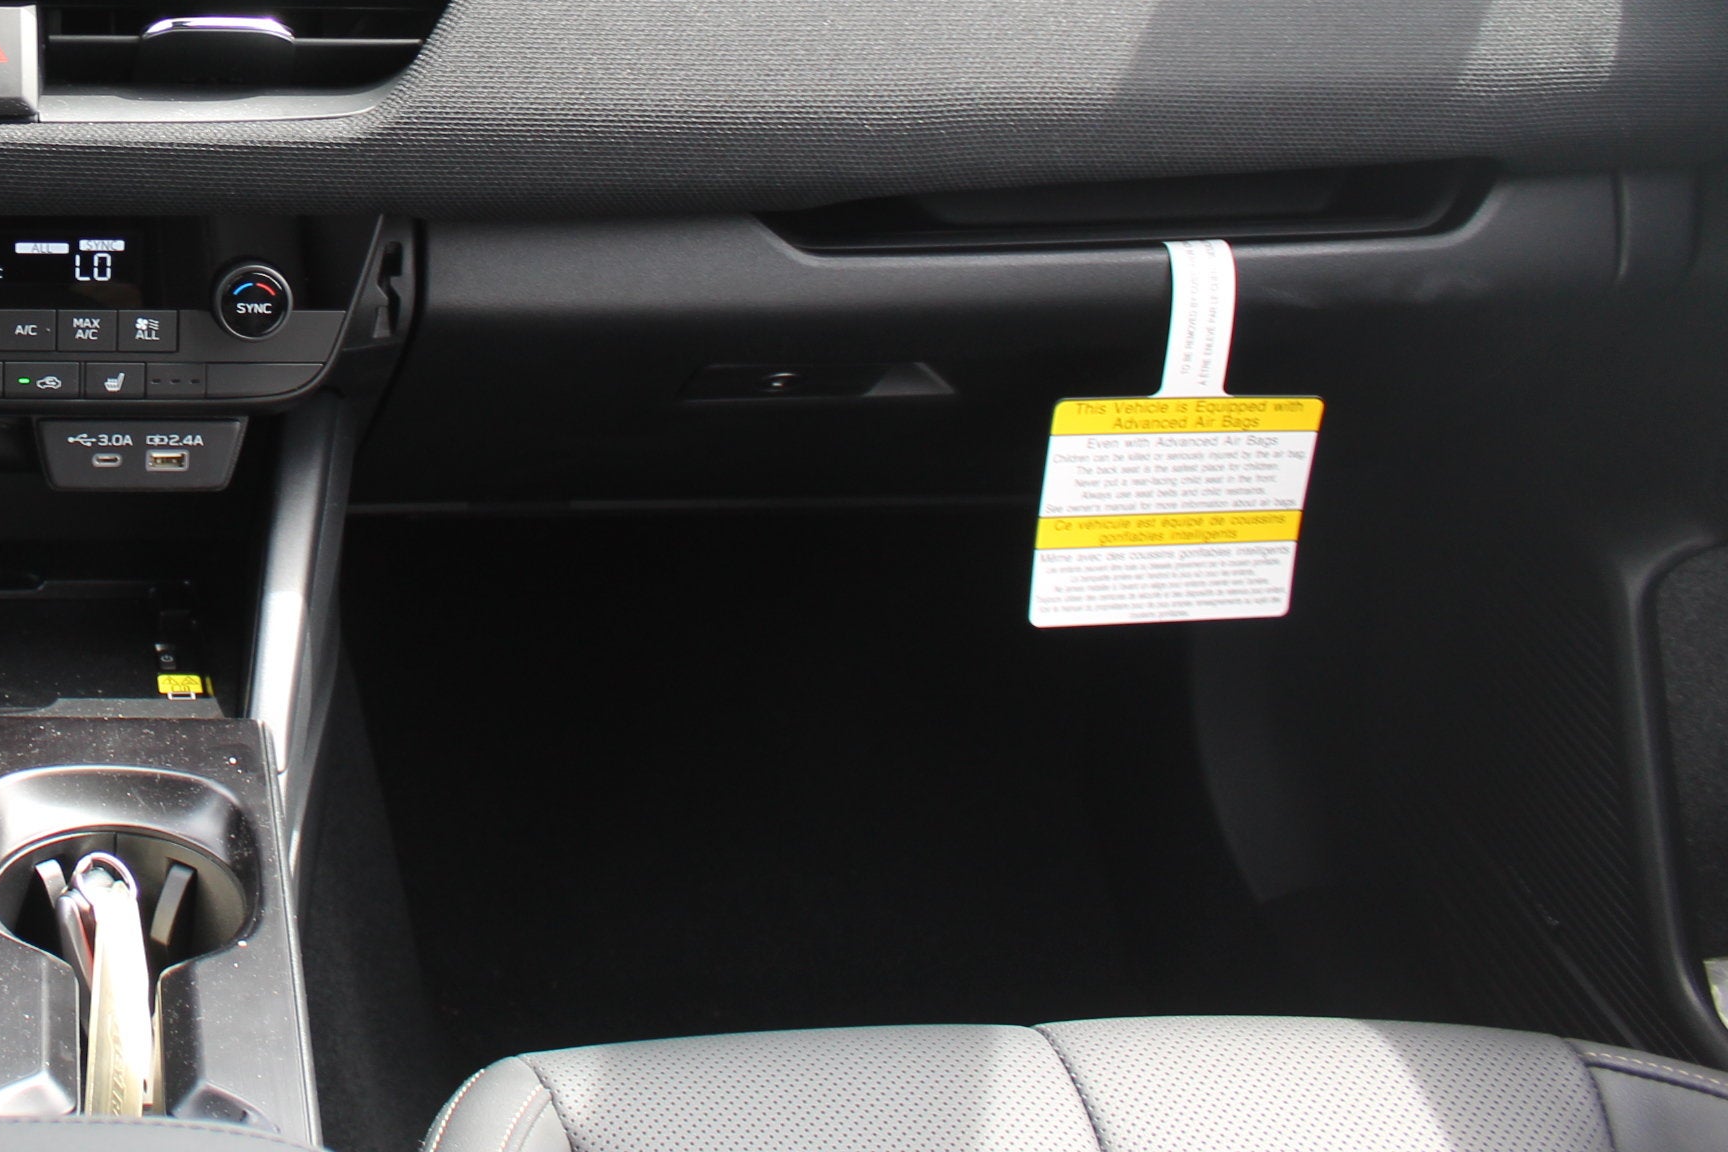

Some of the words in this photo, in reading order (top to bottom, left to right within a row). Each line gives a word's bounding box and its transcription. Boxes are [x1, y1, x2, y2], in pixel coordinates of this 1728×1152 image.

[236, 302, 272, 315] SYNC
[15, 324, 37, 336] A/C
[73, 318, 100, 329] MAX
[75, 329, 98, 340] A/C
[135, 330, 160, 341] ALL
[1076, 402, 1107, 415] This
[1114, 402, 1169, 415] Vehicle
[1175, 401, 1188, 413] is
[1196, 400, 1267, 415] Equipped
[1273, 400, 1304, 412] with
[1113, 416, 1188, 430] Advanced
[1195, 416, 1215, 428] Air
[1221, 415, 1261, 431] Bags
[98, 434, 133, 447] 3.0A
[168, 435, 204, 447] 2.4A
[1087, 438, 1119, 449] Even
[1125, 437, 1150, 448] with
[1155, 436, 1218, 448] Advanced
[1223, 436, 1241, 446] Air
[1246, 435, 1279, 448] Bags
[1054, 519, 1073, 532] Ce
[1136, 518, 1156, 528] est
[1208, 516, 1225, 526] de
[1229, 514, 1286, 525] coussins
[1170, 529, 1239, 544] intelligents
